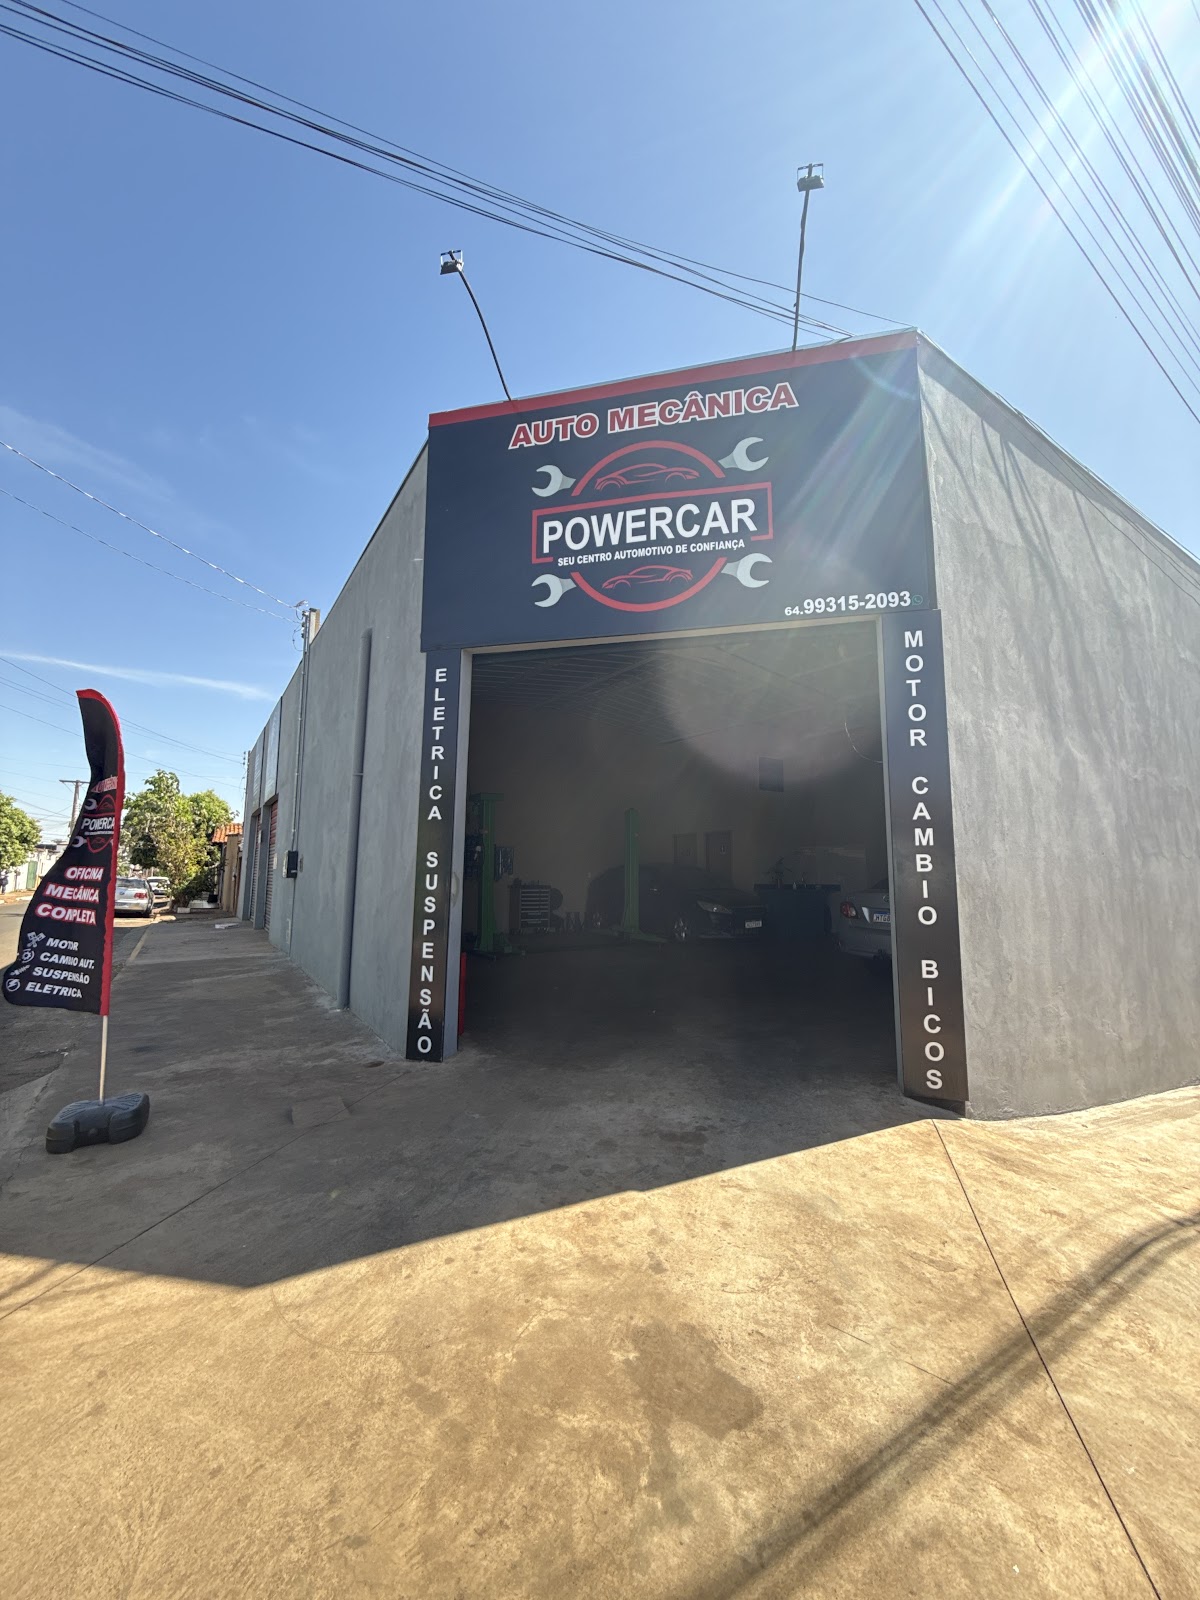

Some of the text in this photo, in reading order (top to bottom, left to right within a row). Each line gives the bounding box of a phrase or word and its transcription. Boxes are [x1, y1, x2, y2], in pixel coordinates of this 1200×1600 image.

[508, 381, 800, 450] AUTO MECÂNICA
[543, 498, 758, 554] POWERCAR
[557, 538, 746, 567] SEU CENTRO AUTOMOTIVO DE CONFIANÇA
[417, 668, 448, 1054] ELETRICA SUSPENSÃO
[904, 630, 945, 1090] MOTOR CAMBIO BICOS
[65, 866, 104, 881] OFICINA
[46, 937, 79, 951] MOTOR
[79, 957, 95, 969] AUT.
[32, 966, 90, 985] SUSPENSÃO
[25, 981, 82, 998] ELETRICA
